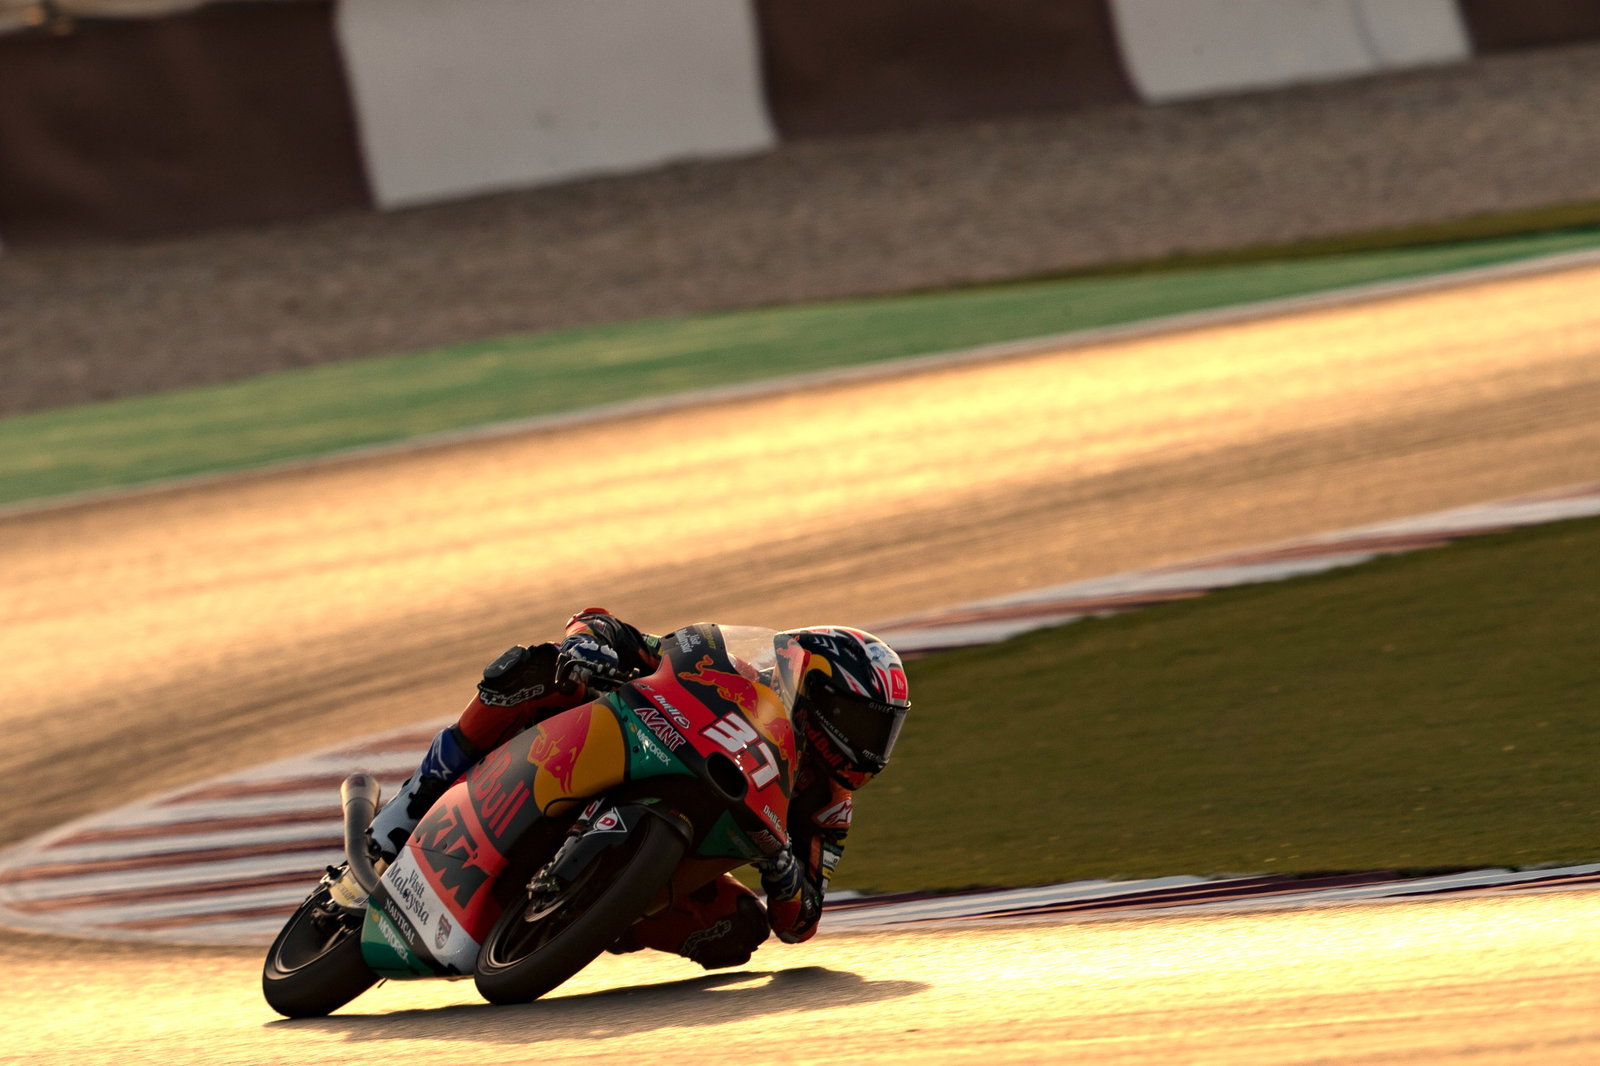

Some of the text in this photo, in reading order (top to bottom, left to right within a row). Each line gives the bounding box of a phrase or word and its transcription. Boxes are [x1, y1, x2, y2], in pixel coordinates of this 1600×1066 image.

[634, 707, 687, 752] AVANT
[636, 729, 672, 767] MOTOREX
[700, 712, 780, 790] 37
[473, 750, 531, 838] Bull
[413, 804, 490, 910] KTM
[387, 862, 430, 926] Malaysia
[409, 869, 426, 899] Visit
[378, 915, 410, 964] MOTOREX
[384, 899, 416, 945] NAUTICAL
